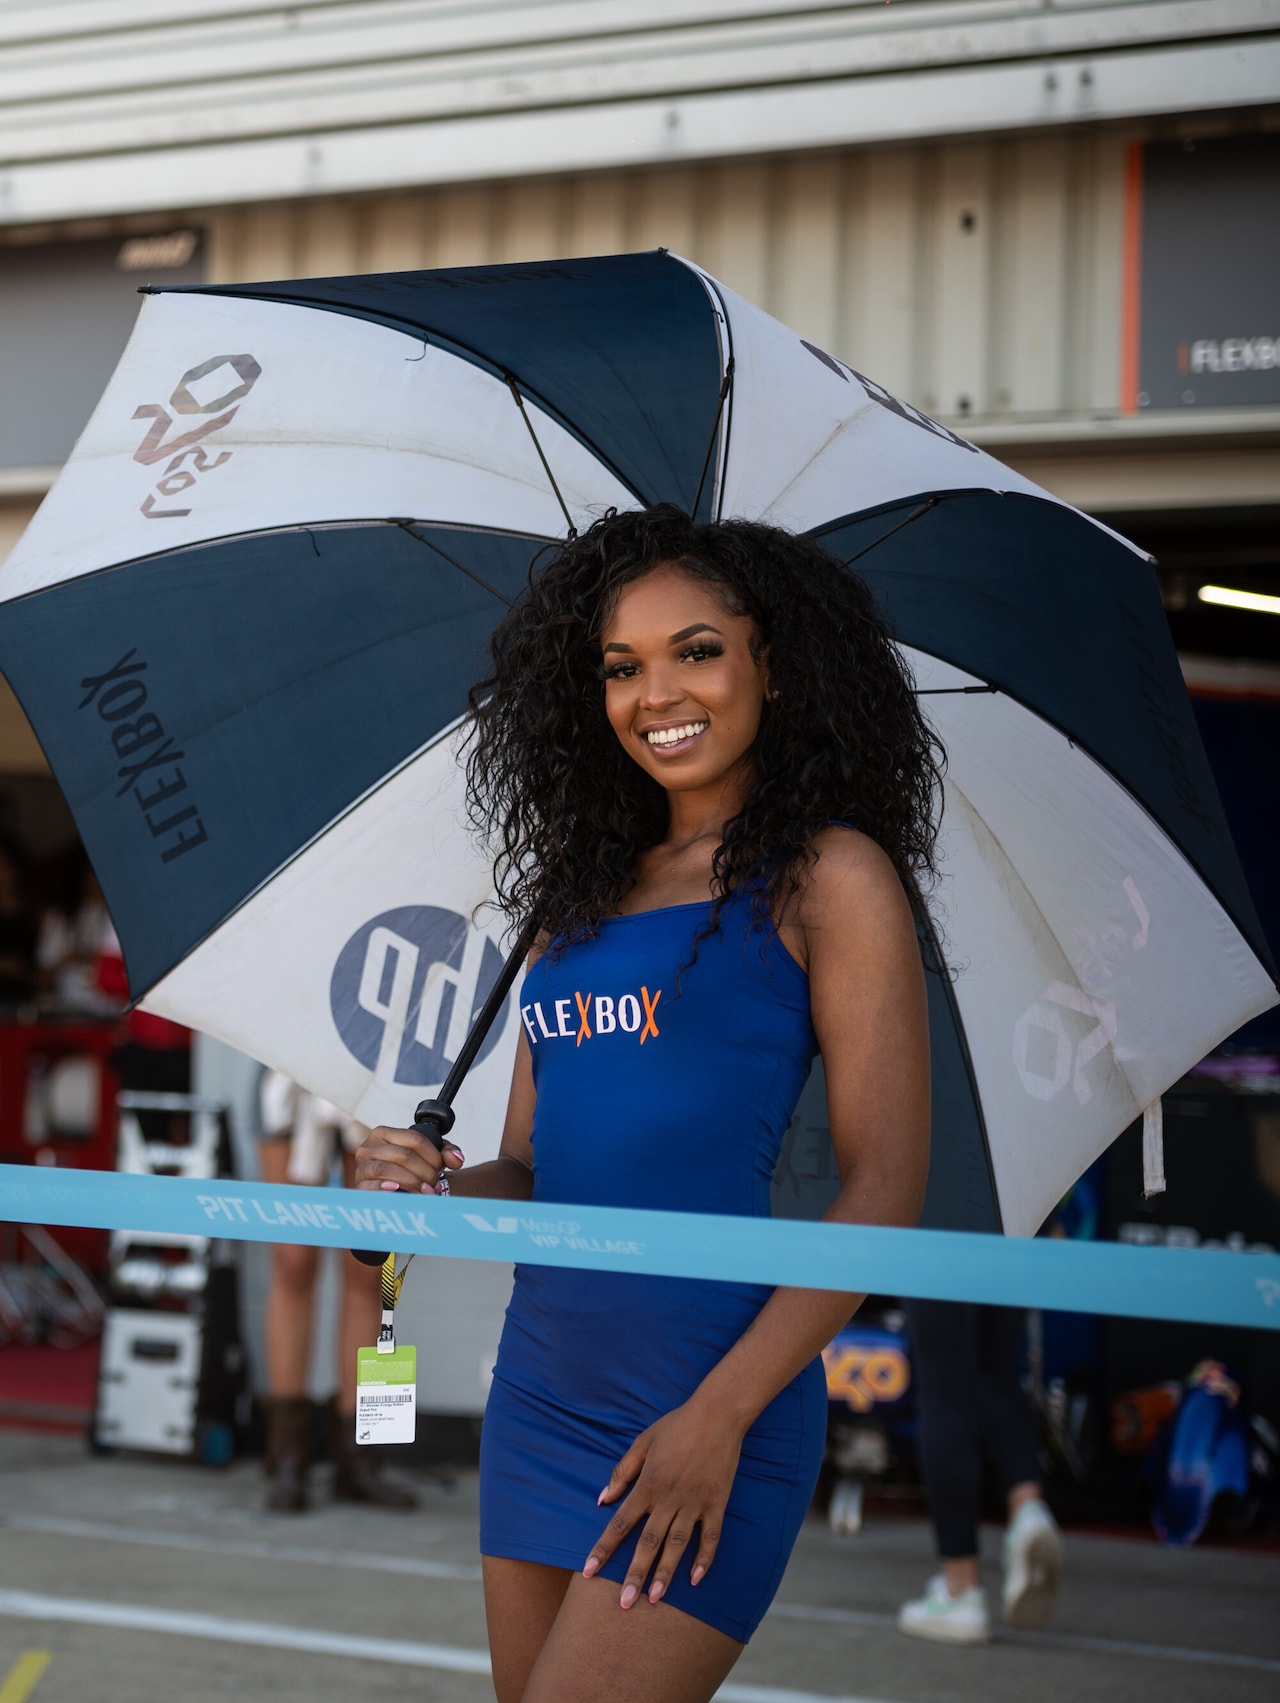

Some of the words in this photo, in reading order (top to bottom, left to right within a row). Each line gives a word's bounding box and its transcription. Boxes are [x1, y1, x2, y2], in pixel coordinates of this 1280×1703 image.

[1191, 337, 1280, 374] FLEXB
[521, 985, 662, 1047] FLEXBOX
[196, 1195, 249, 1222] PIT
[251, 1199, 342, 1230] LANE
[336, 1205, 438, 1238] WALK
[520, 1217, 581, 1236] MotoGP
[529, 1233, 560, 1248] VIP
[563, 1237, 645, 1255] VILLAGE
